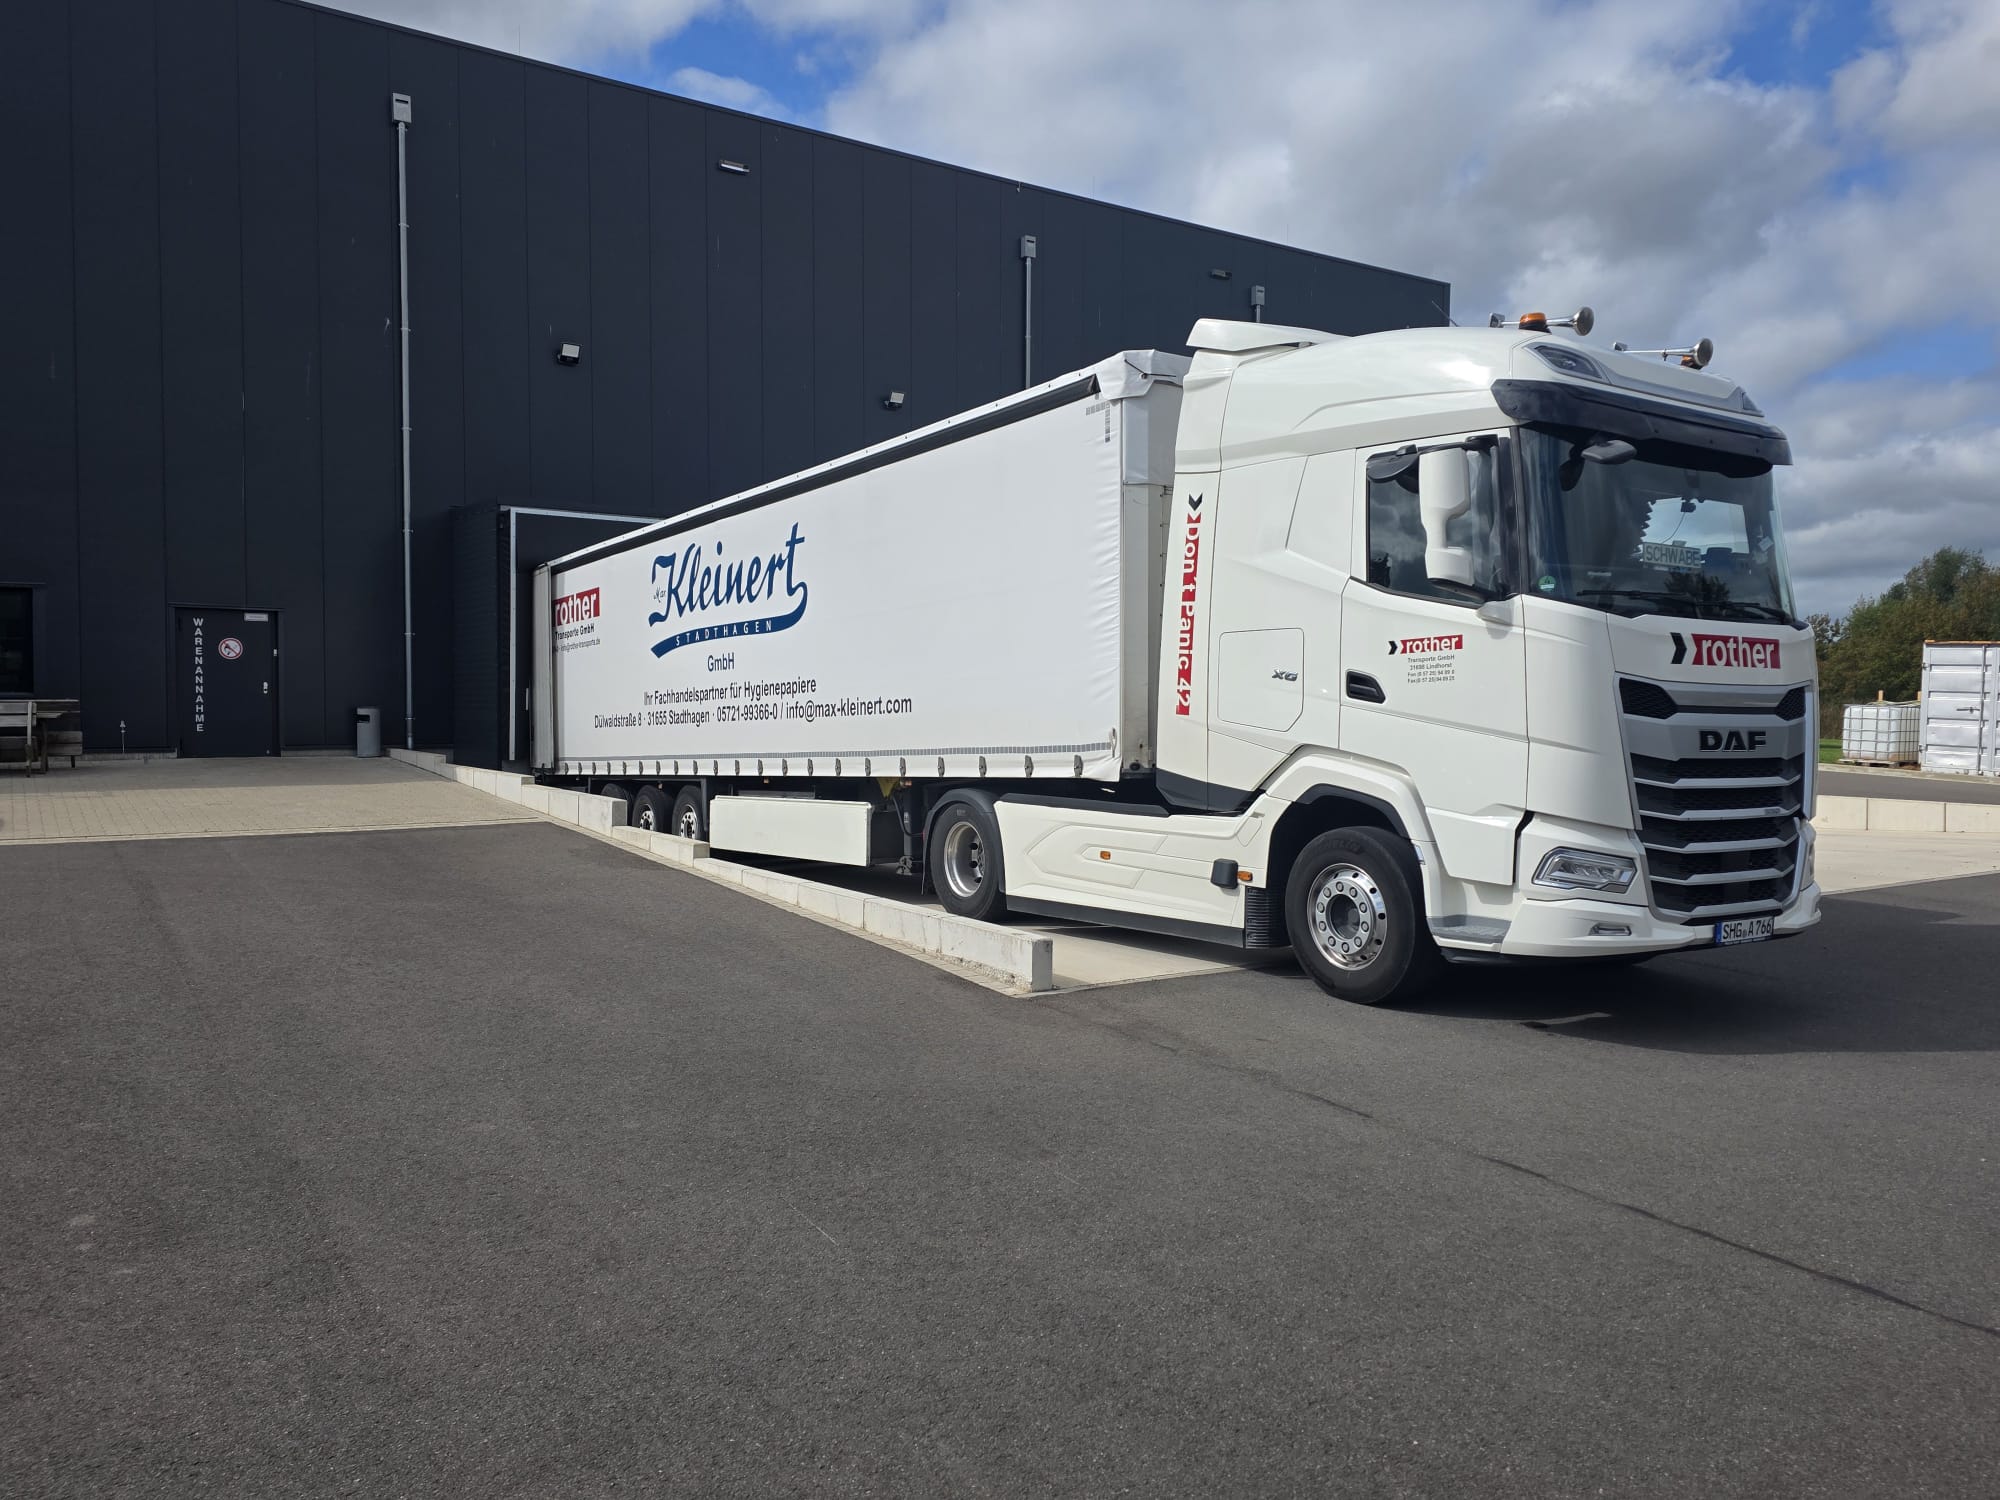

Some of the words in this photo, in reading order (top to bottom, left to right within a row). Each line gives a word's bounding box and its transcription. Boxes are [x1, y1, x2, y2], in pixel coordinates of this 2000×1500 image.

[1645, 544, 1700, 567] SCHWABE
[649, 522, 807, 627] Kleinert
[555, 593, 597, 627] rother
[554, 628, 579, 640] Transporte
[580, 622, 595, 635] GmbH
[675, 620, 772, 646] STADTHAGEN
[1178, 601, 1195, 670] Panic
[1406, 636, 1459, 653] rother
[707, 652, 735, 671] GmbH
[1437, 653, 1455, 661] GmbH
[1702, 636, 1775, 669] rother
[193, 617, 204, 732] WARENANNAHME
[643, 691, 653, 706] Ihr
[654, 685, 728, 705] Fachhandelspartner
[730, 682, 742, 699] für
[744, 676, 817, 701] Hygienepapiere
[1176, 678, 1191, 707] 42
[594, 712, 637, 729] Dülwaldstraße
[637, 712, 642, 727] 8
[647, 710, 667, 726] 31655
[669, 708, 710, 727] Stadthagen
[716, 702, 778, 722] 05721-99366-0
[786, 696, 912, 723] info@max-kleinert.com
[1699, 730, 1766, 752] DAF
[1723, 922, 1742, 940] SHG
[1748, 920, 1754, 936] A
[1756, 919, 1772, 935] 766
